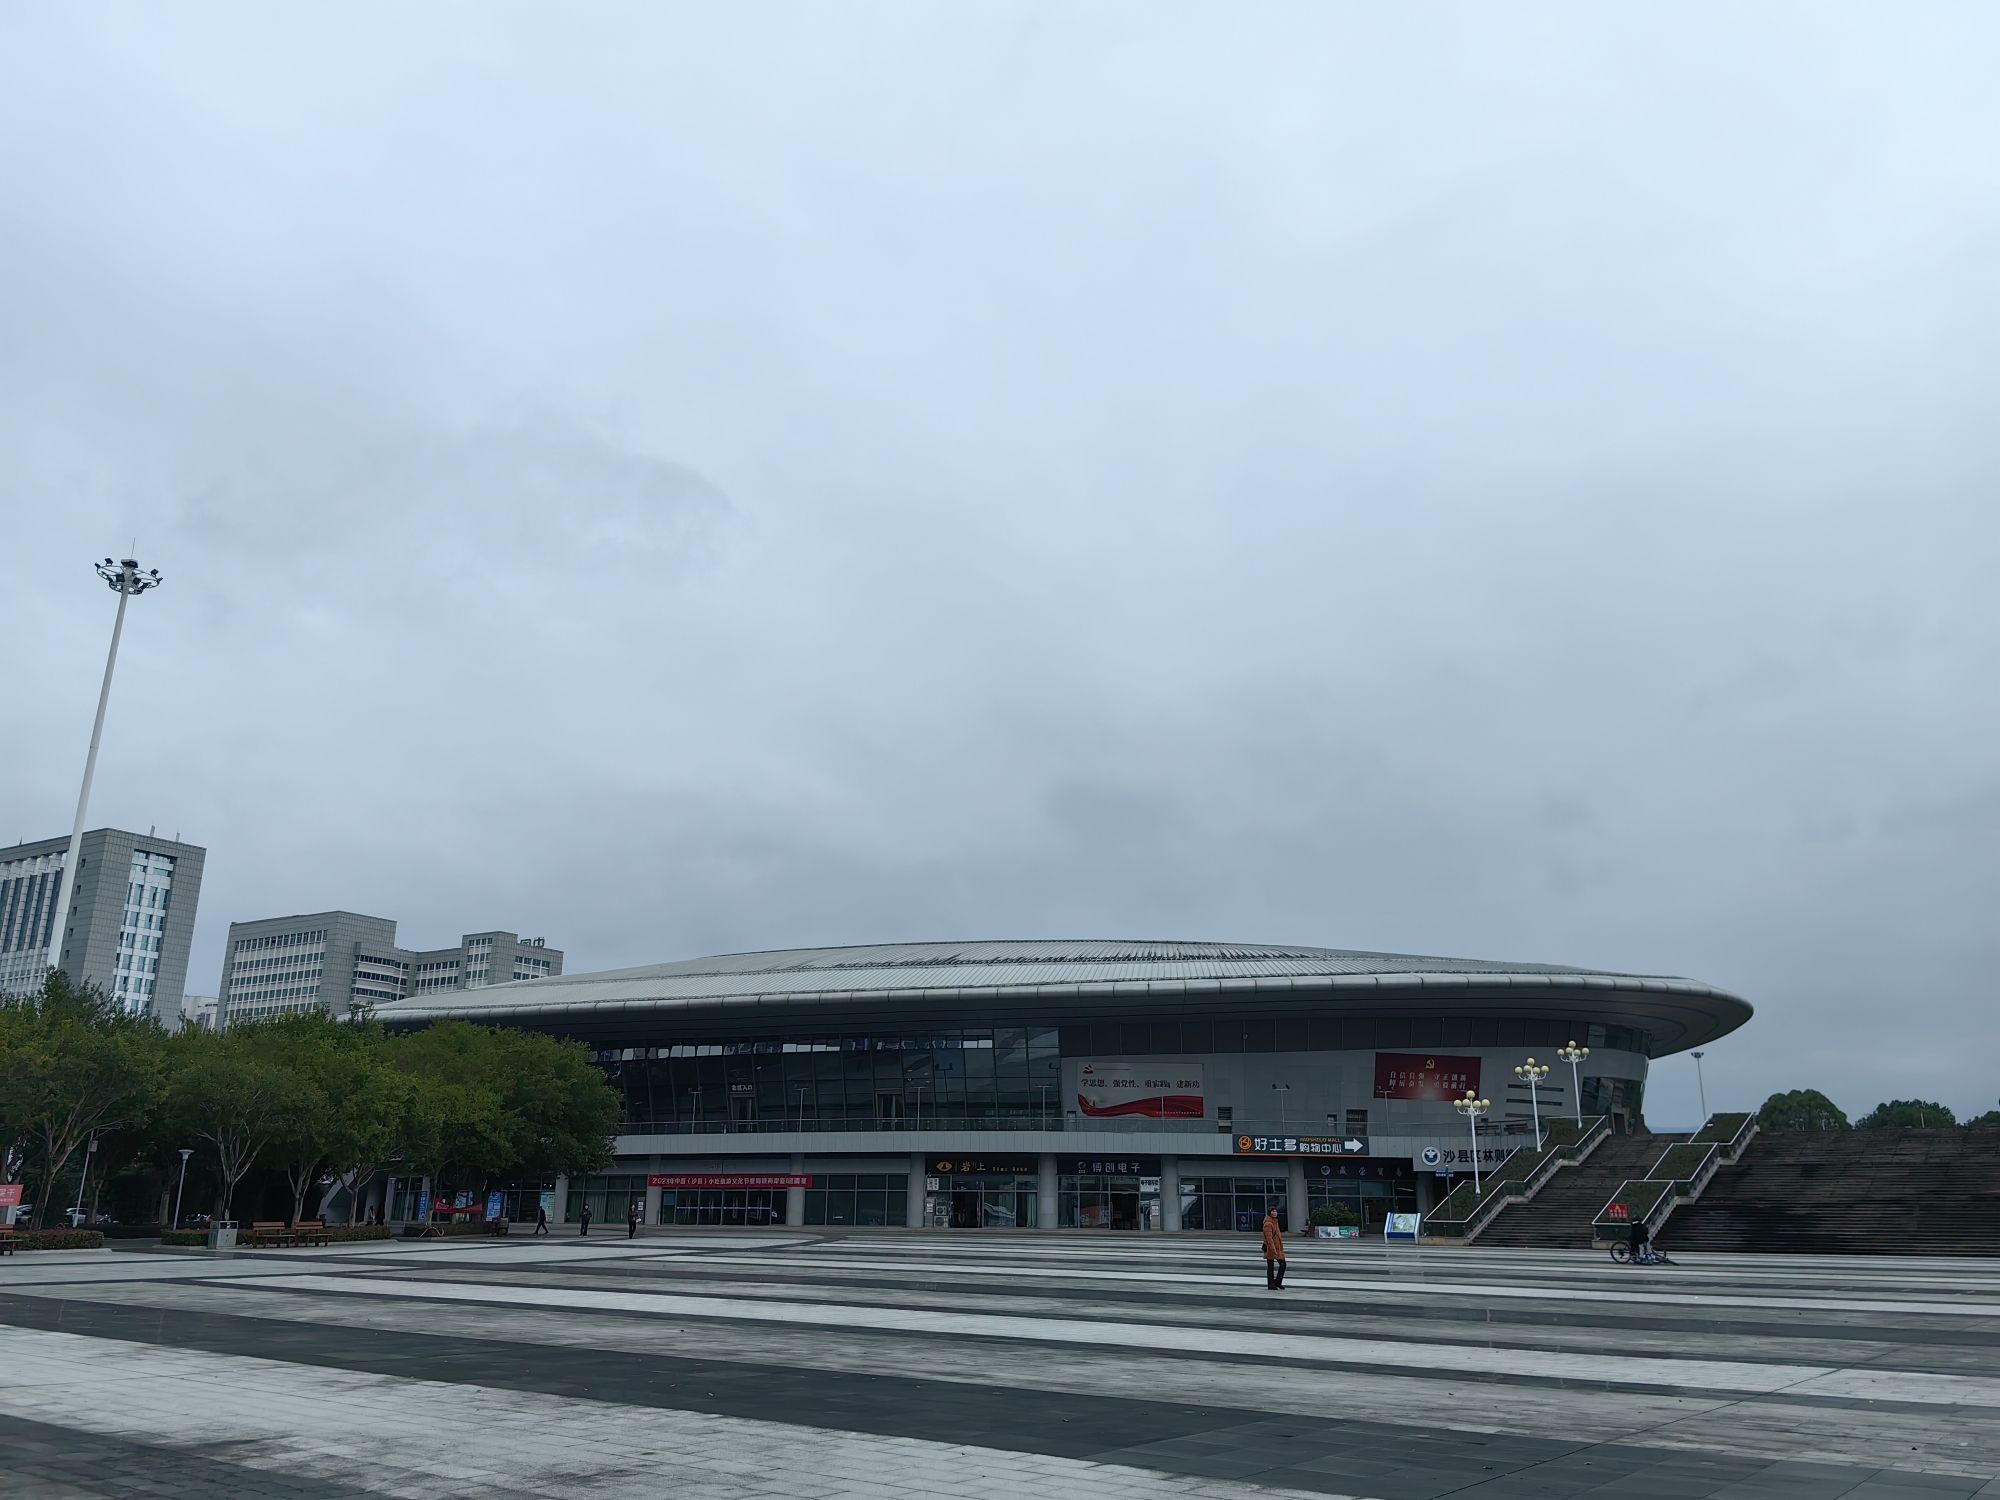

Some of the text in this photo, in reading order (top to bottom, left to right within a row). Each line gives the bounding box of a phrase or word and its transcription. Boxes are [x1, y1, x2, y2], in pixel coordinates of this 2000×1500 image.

[1254, 1138, 1297, 1152] 好士多
[1299, 1143, 1342, 1153] 购物中心
[960, 1160, 987, 1172] 岩上
[1092, 1162, 1141, 1173] 博创电子
